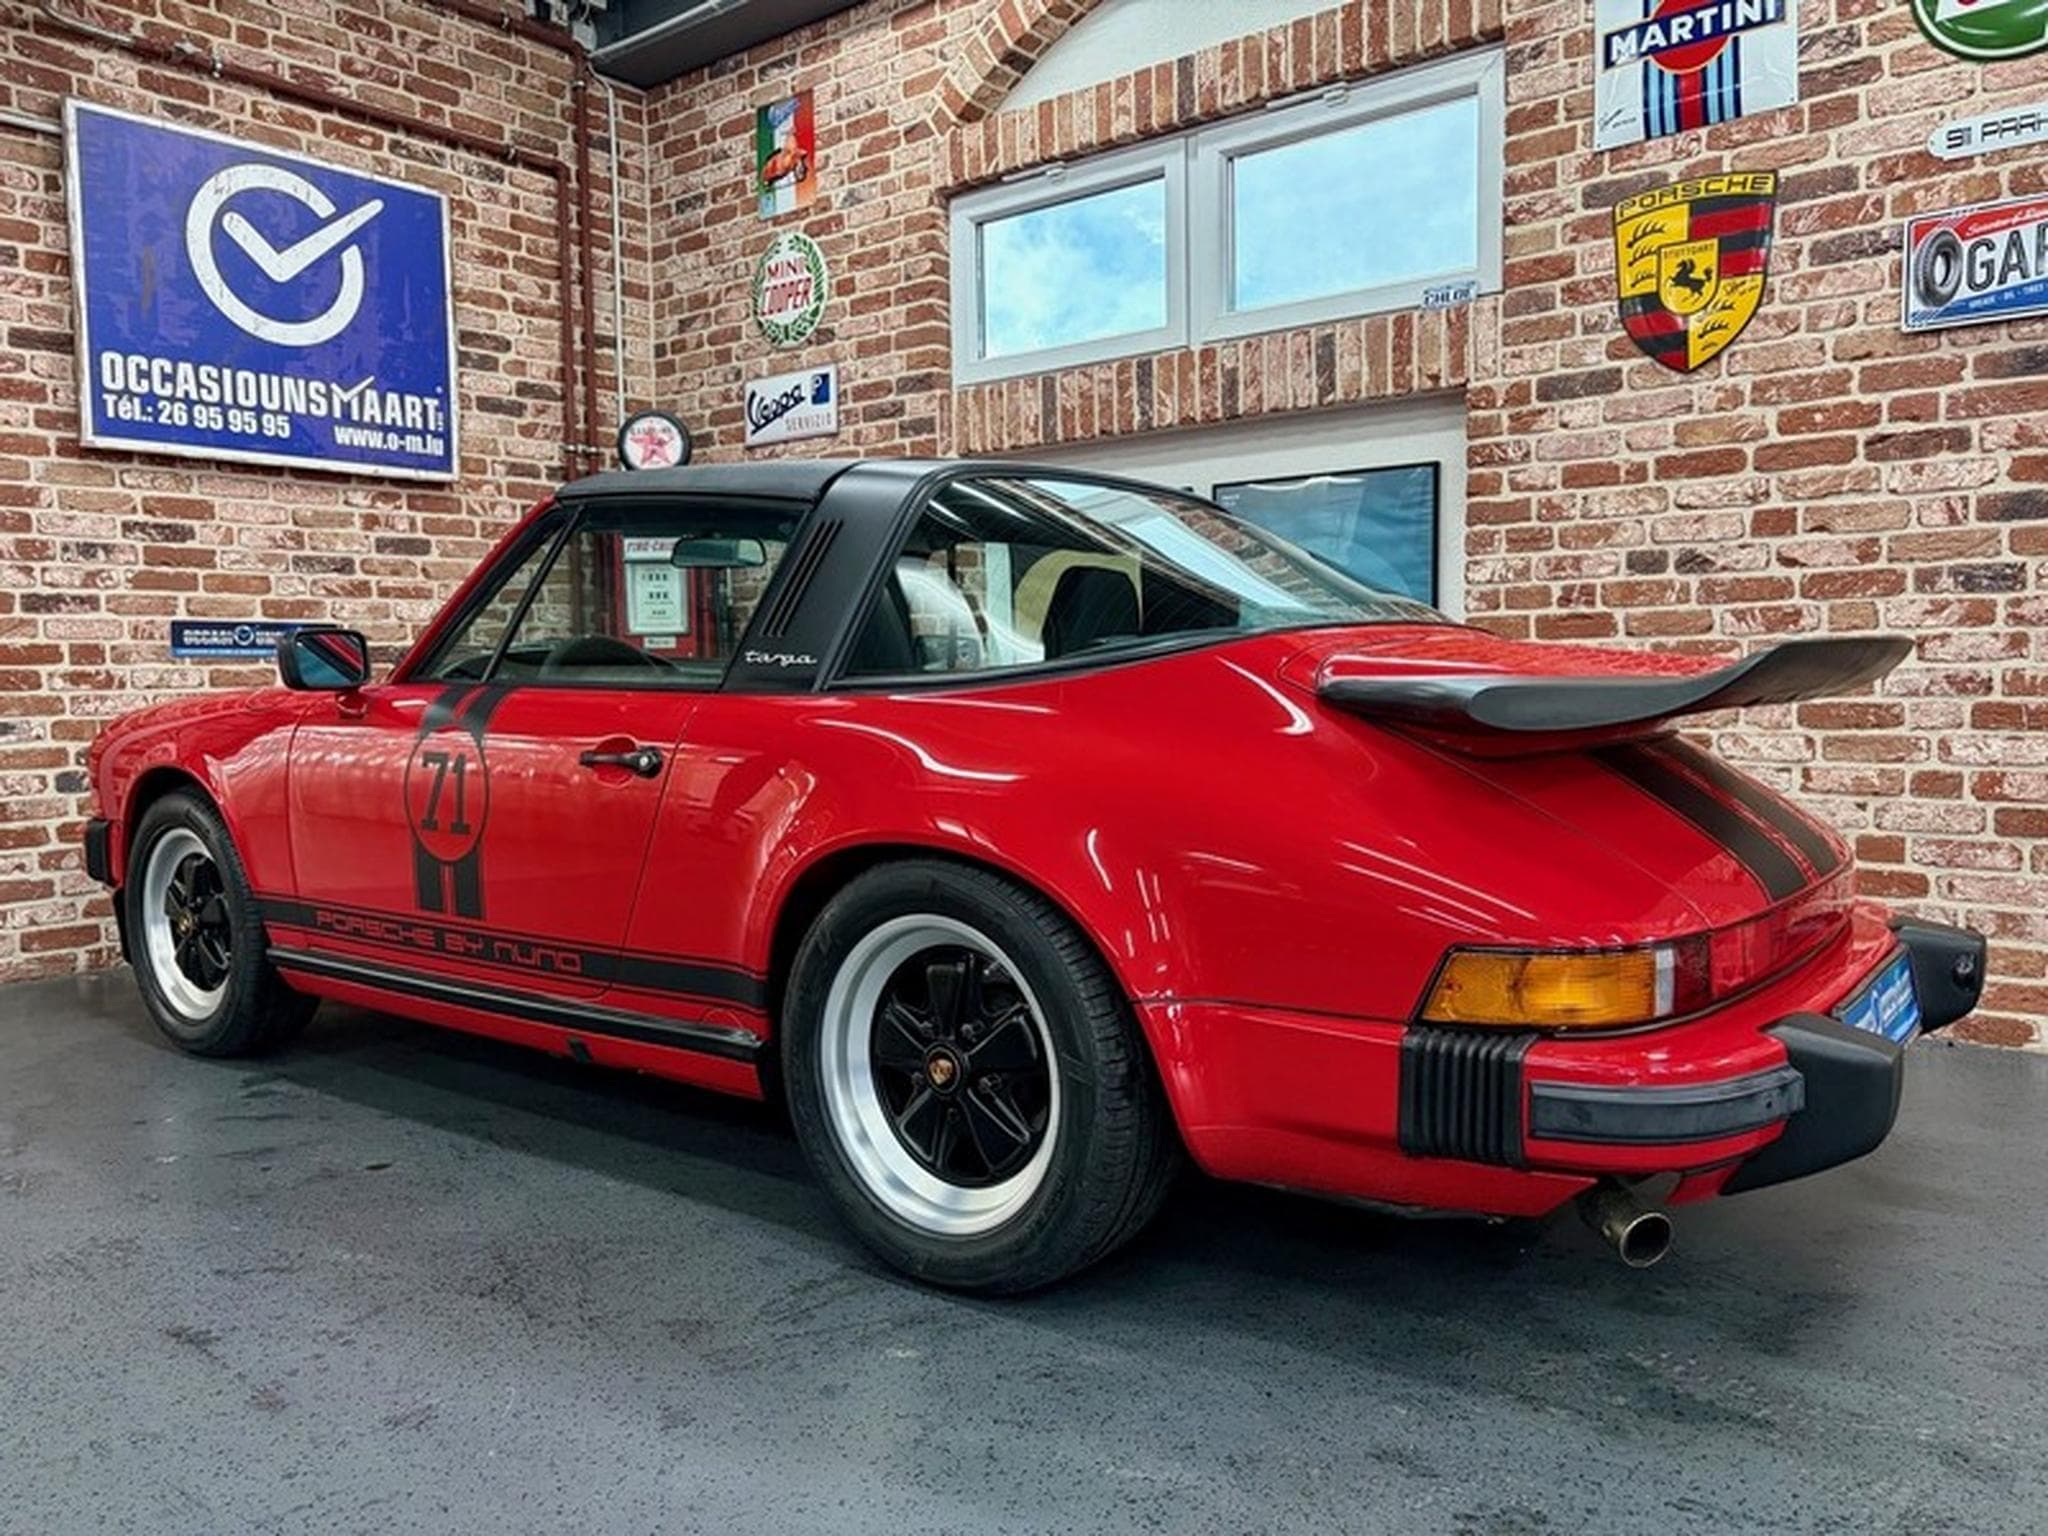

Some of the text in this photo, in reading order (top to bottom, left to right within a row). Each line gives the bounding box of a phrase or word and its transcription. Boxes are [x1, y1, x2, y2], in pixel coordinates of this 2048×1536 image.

[1610, 0, 1777, 62] MARTINI
[1619, 175, 1771, 218] PORSCHE
[760, 276, 812, 317] COOPER
[101, 392, 292, 439] Tél.: 26 95 95 95
[747, 383, 807, 437] Vespa
[333, 424, 445, 457] www.o-m.lu
[744, 649, 818, 668] targa
[421, 751, 471, 835] 71
[315, 909, 436, 949] PORSCHE
[444, 930, 483, 954] BY
